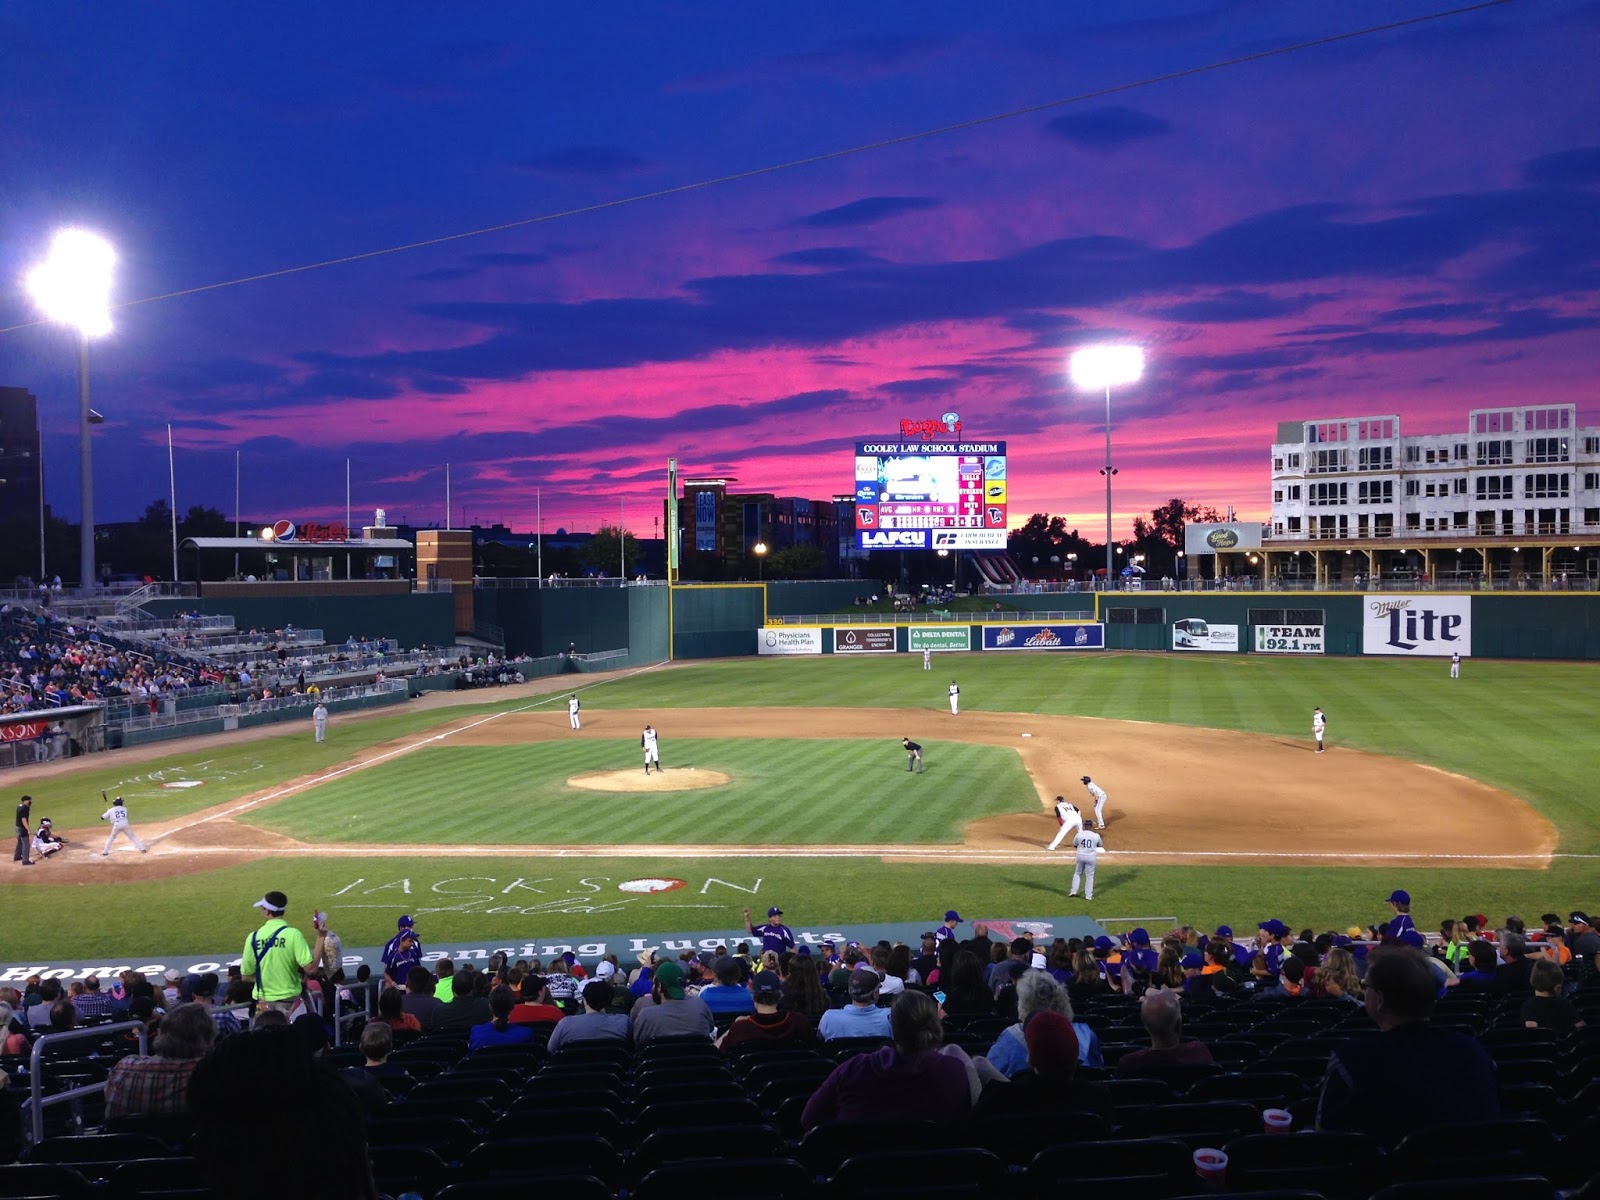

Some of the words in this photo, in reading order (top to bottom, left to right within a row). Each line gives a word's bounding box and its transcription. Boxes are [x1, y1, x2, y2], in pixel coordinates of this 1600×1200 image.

[863, 444, 898, 453] COOLEY
[901, 444, 919, 453] LAW
[922, 444, 957, 453] SCHOOL
[959, 444, 997, 453] STADIUM
[696, 494, 714, 506] LEASE
[696, 506, 714, 522] NOW
[862, 531, 925, 544] LAFCU
[1210, 532, 1229, 543] Good
[1215, 539, 1235, 547] Hops
[1370, 600, 1412, 619] Miller
[1270, 627, 1321, 638] TEAM
[1385, 608, 1462, 650] Lite
[996, 631, 1016, 646] Blue
[1023, 636, 1062, 647] Labatt
[1266, 638, 1300, 650] 92.1
[114, 810, 126, 819] 25
[1081, 839, 1092, 848] 40
[252, 937, 286, 950] ENOR
[0, 964, 166, 982] Home
[420, 942, 607, 962] ansing
[629, 931, 847, 952] Lugnts
